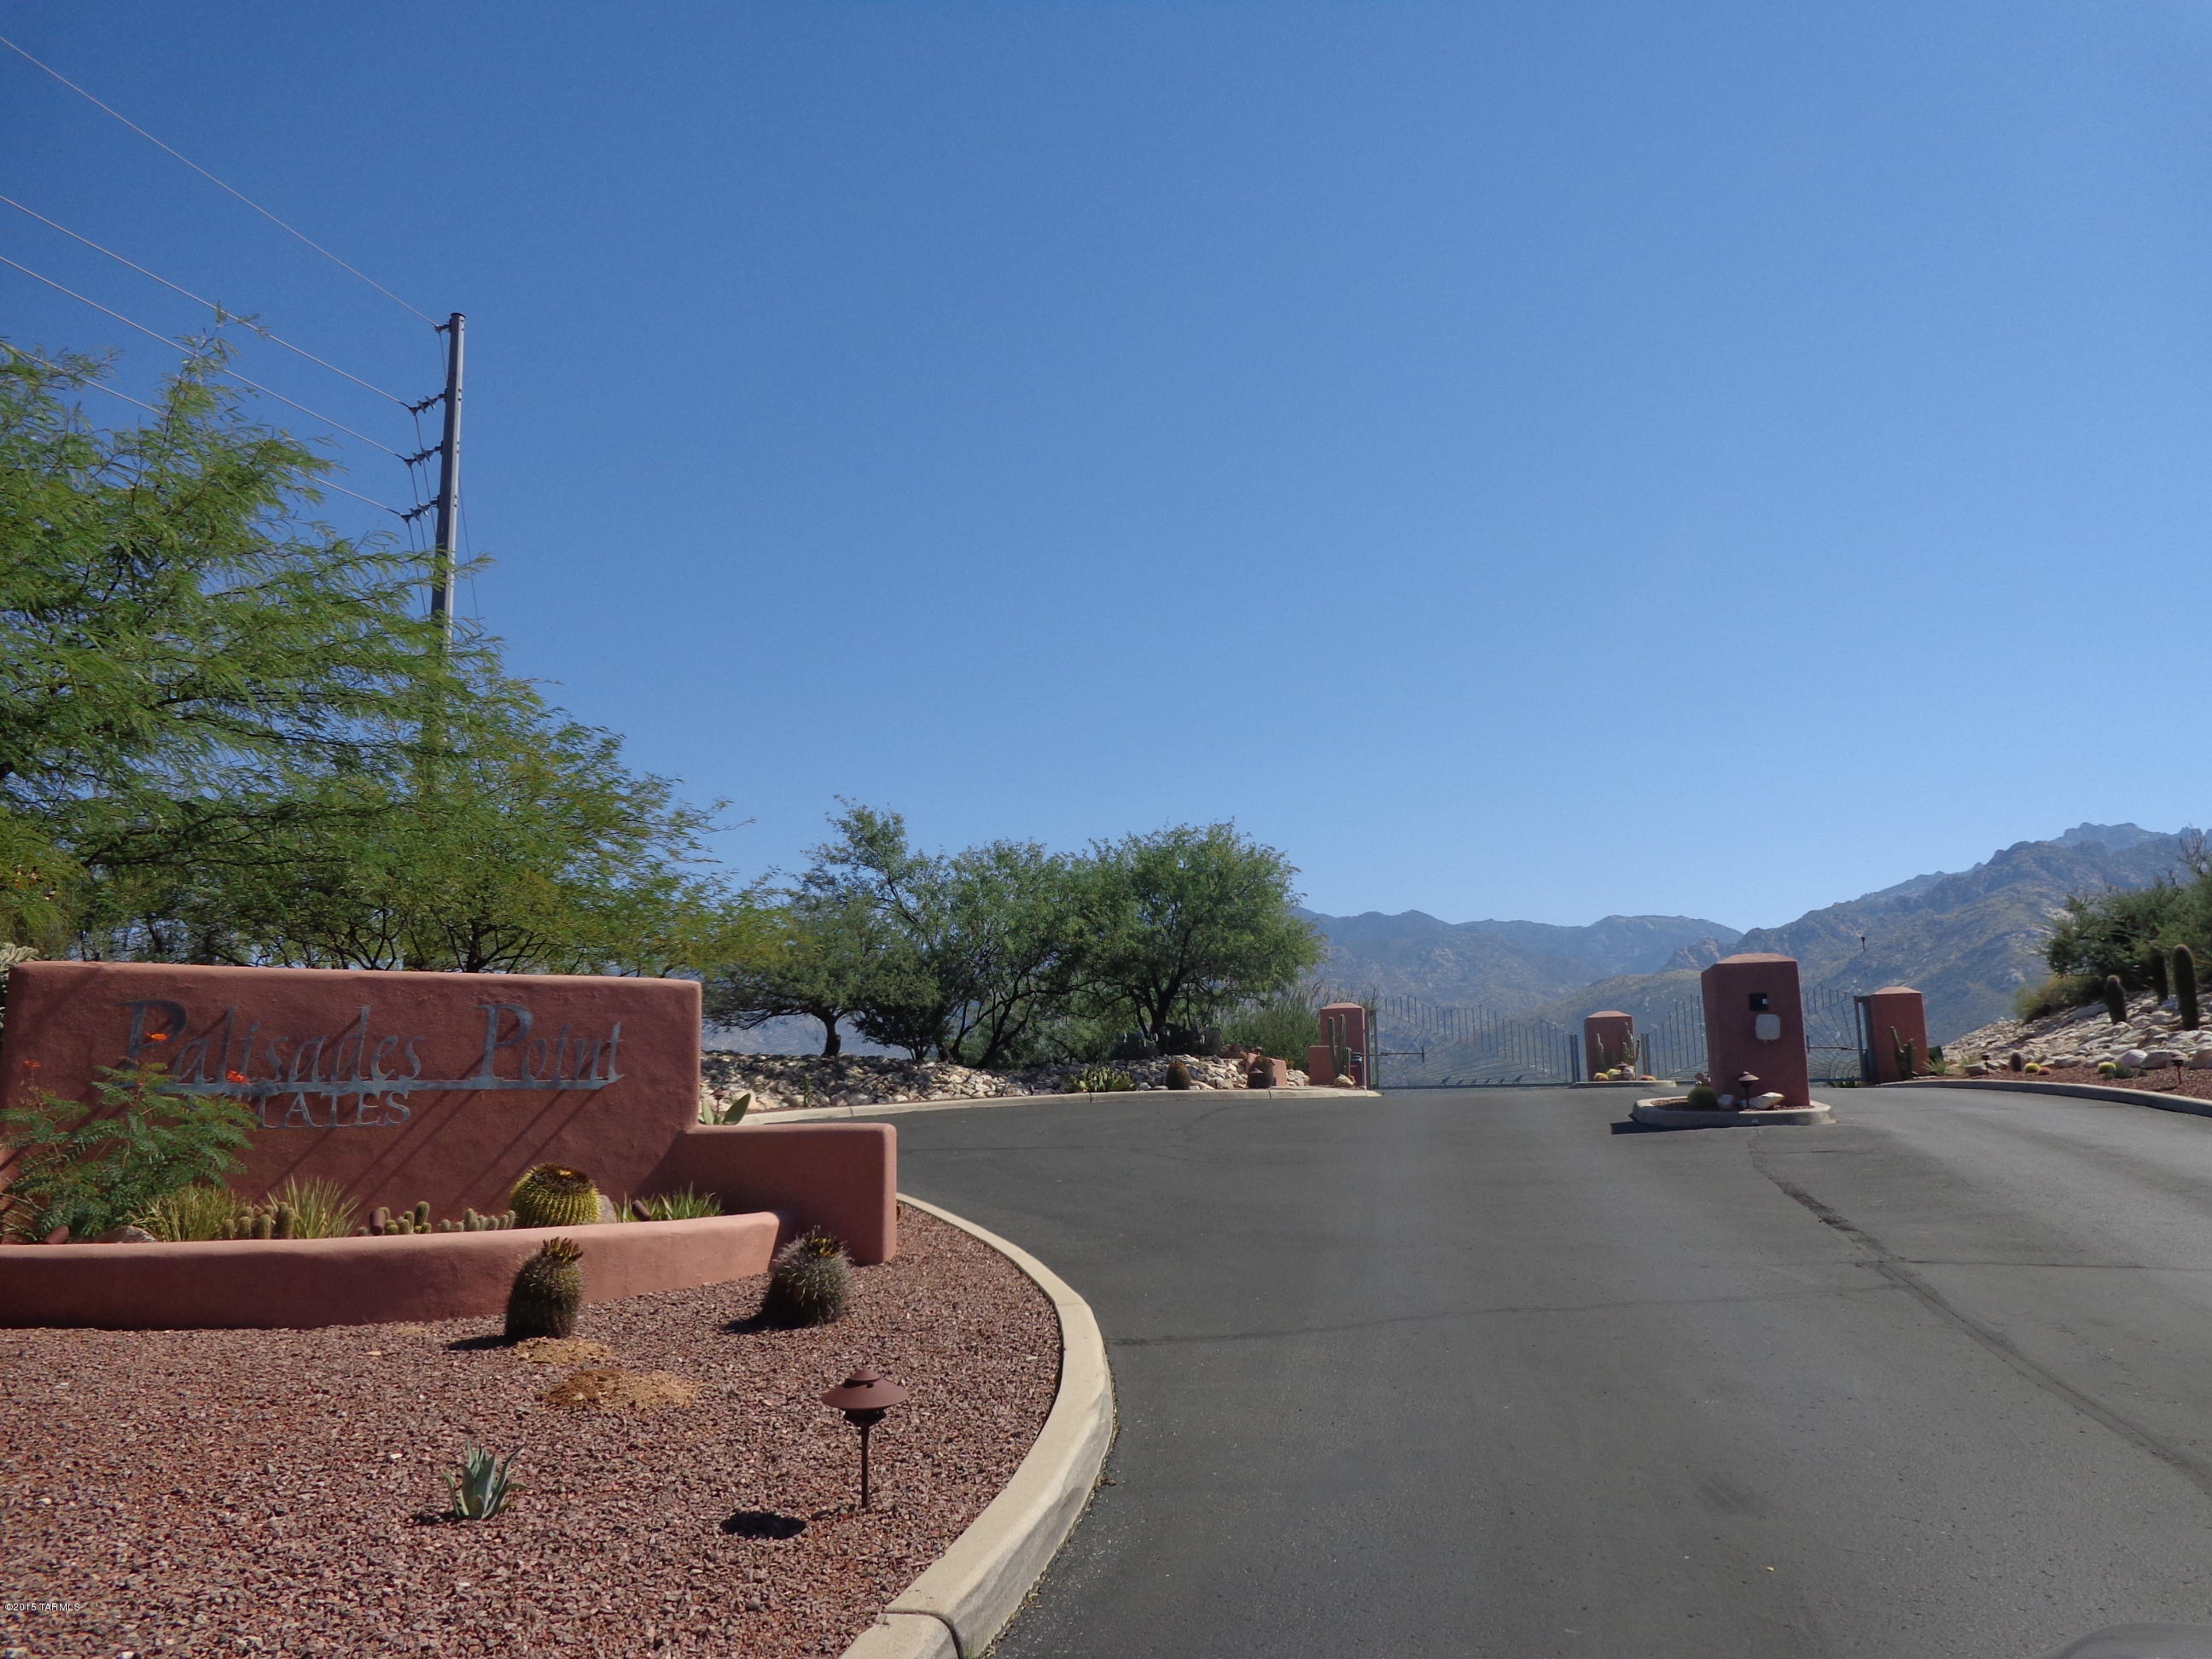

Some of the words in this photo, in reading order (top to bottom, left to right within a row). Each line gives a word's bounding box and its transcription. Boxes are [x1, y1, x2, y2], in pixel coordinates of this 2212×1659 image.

[115, 998, 426, 1086] Palisades
[474, 1002, 627, 1086] Point
[192, 1090, 411, 1128] TATES
